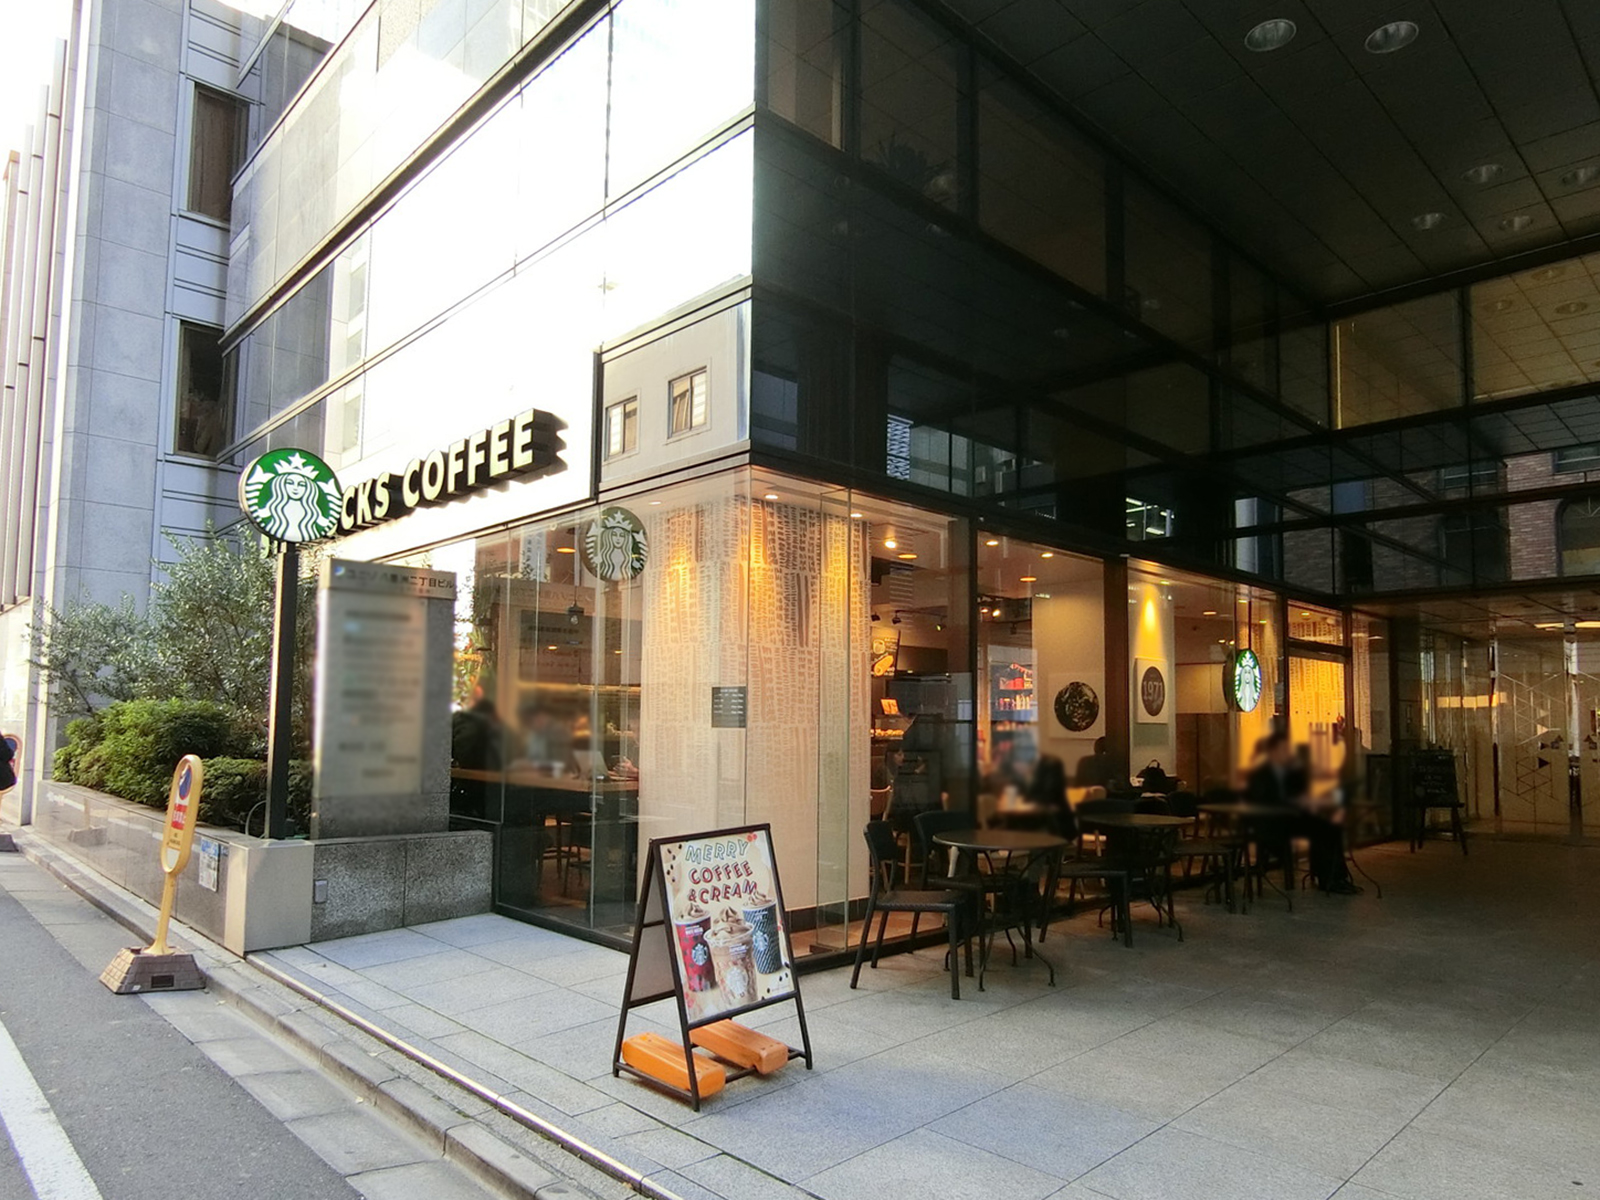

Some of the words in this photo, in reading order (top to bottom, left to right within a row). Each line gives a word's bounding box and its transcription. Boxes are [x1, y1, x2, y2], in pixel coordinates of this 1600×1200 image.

[402, 408, 536, 508] COFFEE
[1143, 681, 1164, 701] 1971
[686, 839, 749, 865] MERRY
[688, 860, 754, 885] COFFEE
